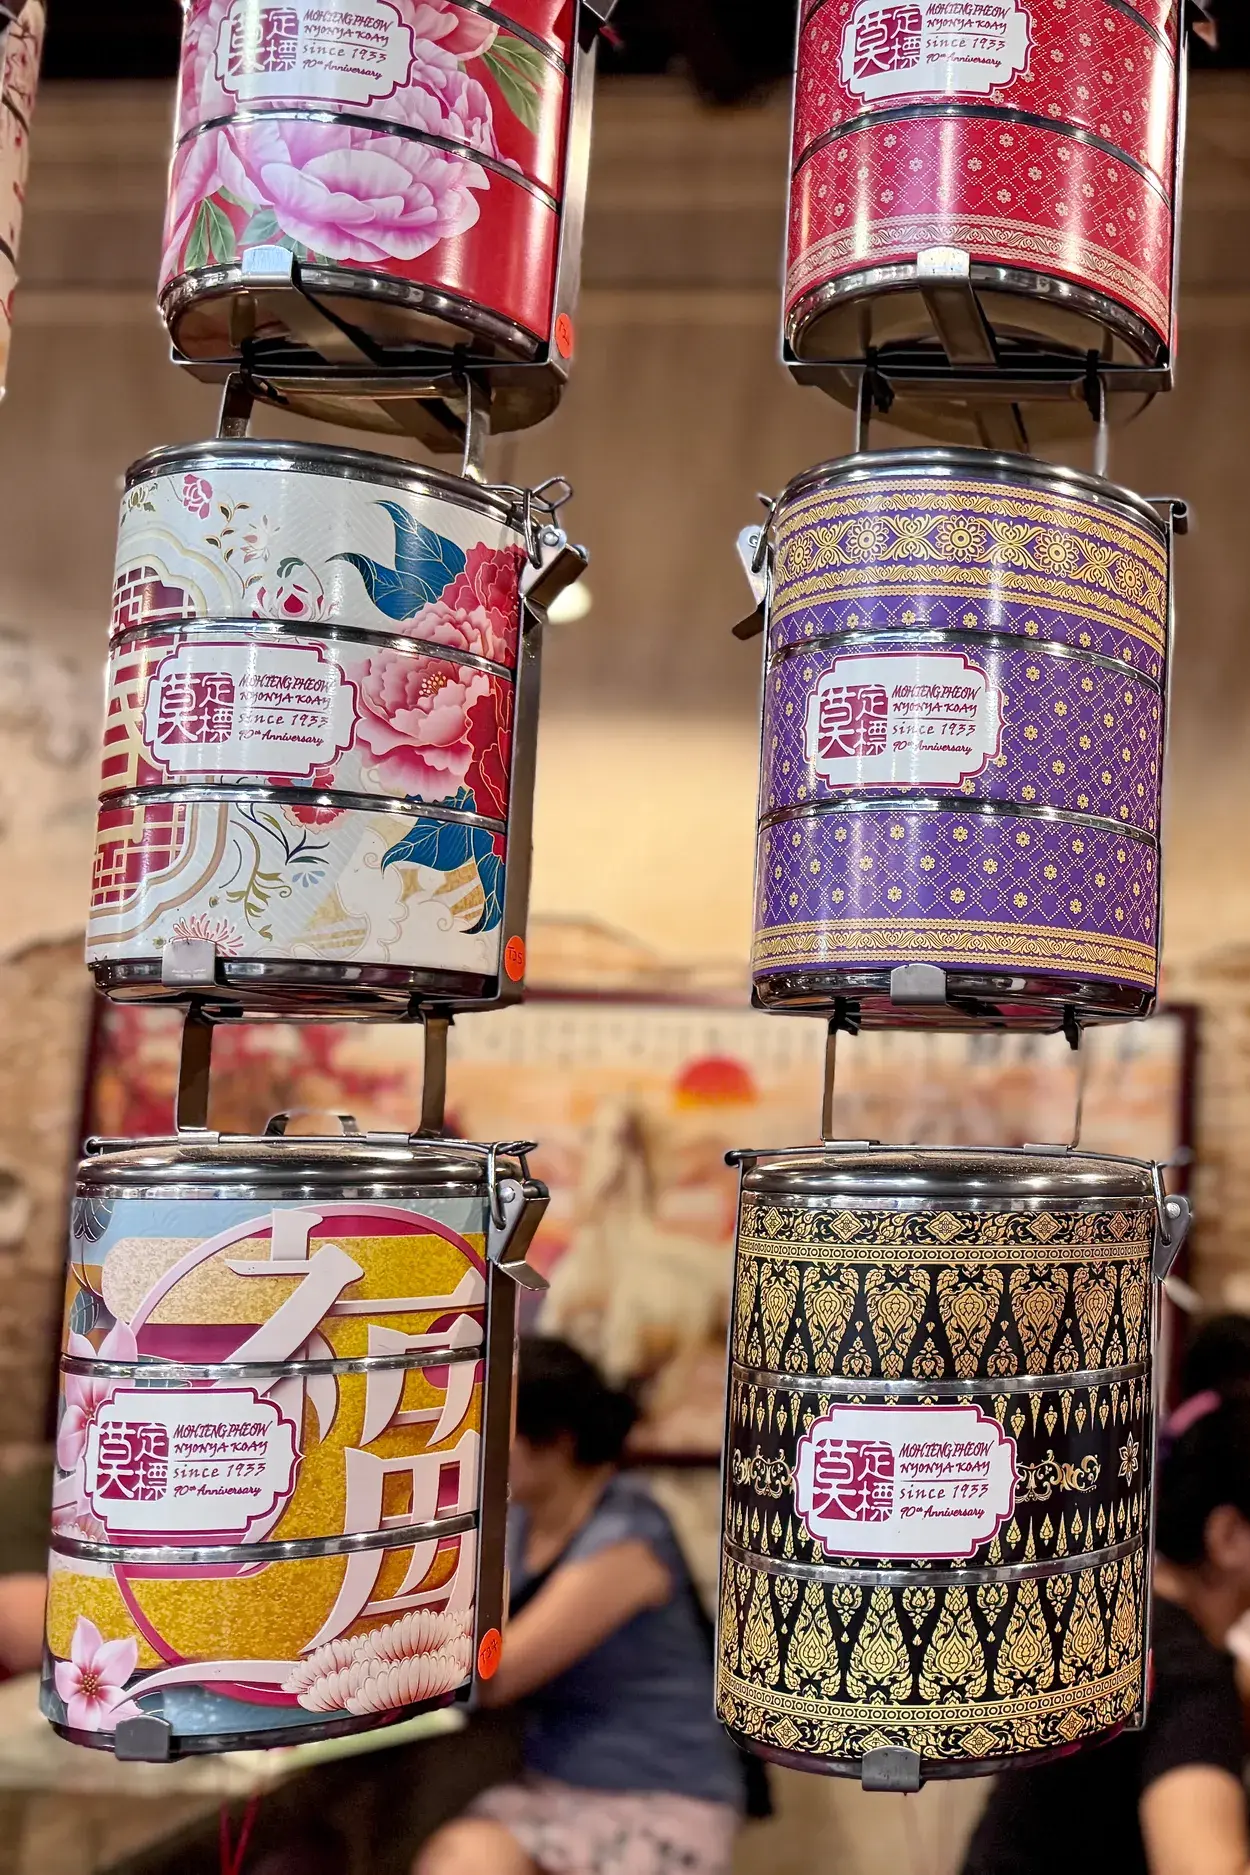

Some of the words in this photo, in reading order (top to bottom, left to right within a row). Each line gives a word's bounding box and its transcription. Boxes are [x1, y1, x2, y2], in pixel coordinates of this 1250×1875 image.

[927, 19, 975, 31] NYONYA
[977, 21, 1007, 34] KOAY
[304, 25, 354, 39] NYONYA
[356, 31, 389, 47] KOAY
[926, 36, 966, 48] since
[973, 38, 1006, 50] 1933
[303, 42, 345, 56] since
[352, 48, 387, 63] 1933
[948, 53, 1001, 67] Anniversary
[324, 61, 382, 79] Anniversary
[295, 695, 331, 710] KOAY
[893, 702, 942, 716] NYONYA
[946, 703, 977, 717] KOAY
[291, 714, 328, 728] 1933
[892, 722, 934, 734] since
[941, 723, 976, 735] 1933
[262, 730, 324, 746] Anniversary
[917, 740, 972, 755] Anniversary
[174, 1443, 228, 1457] NYONYA
[231, 1441, 268, 1455] KOAY
[173, 1464, 219, 1478] since
[227, 1463, 266, 1477] 1933
[900, 1462, 954, 1478] NYONYA
[956, 1461, 990, 1476] KOAY
[197, 1484, 261, 1497] Anniversary
[900, 1484, 945, 1499] since
[953, 1484, 989, 1498] 1933
[923, 1505, 985, 1519] Anniversary
